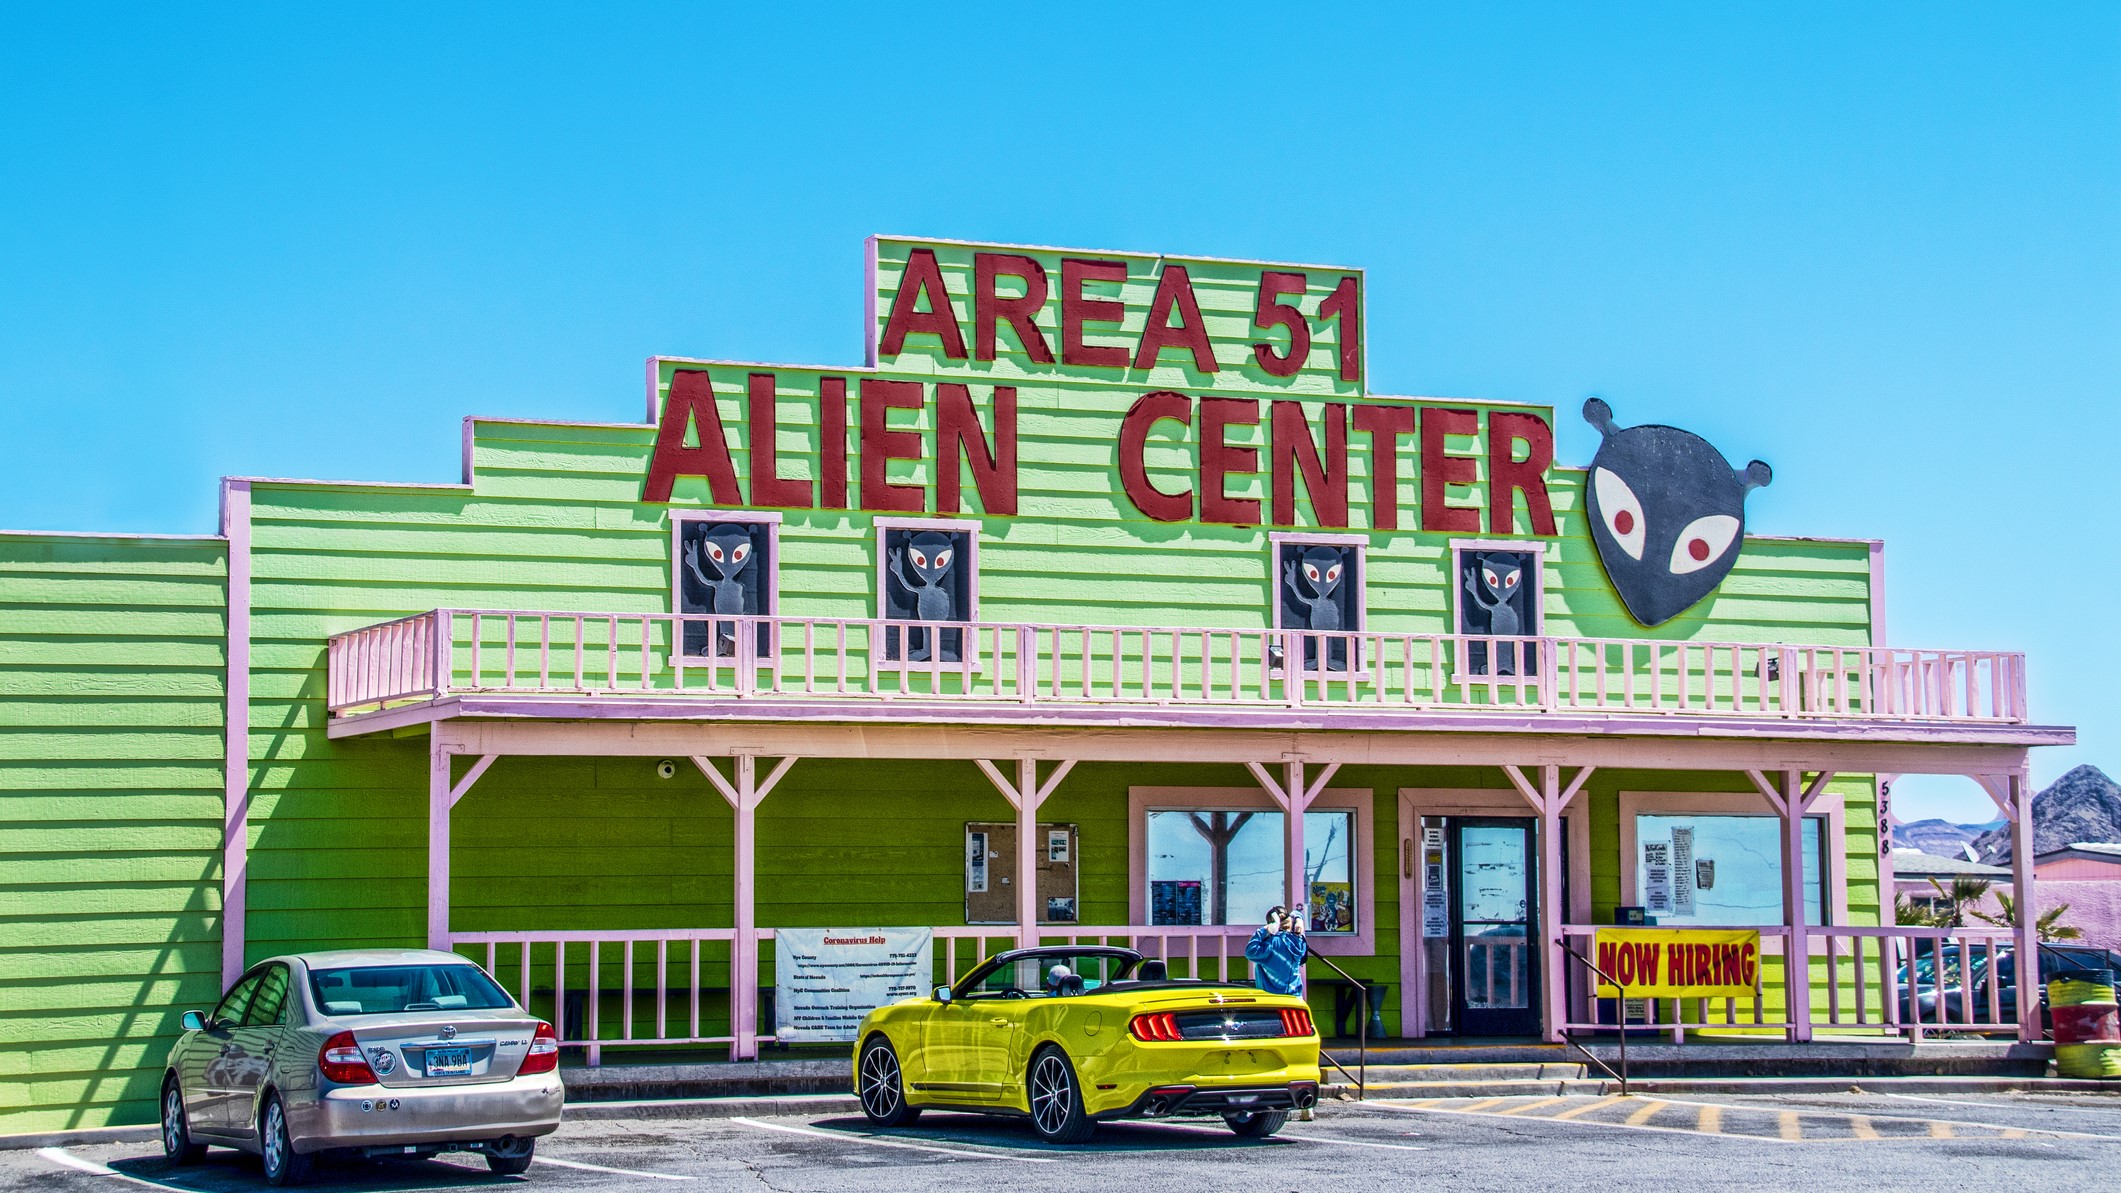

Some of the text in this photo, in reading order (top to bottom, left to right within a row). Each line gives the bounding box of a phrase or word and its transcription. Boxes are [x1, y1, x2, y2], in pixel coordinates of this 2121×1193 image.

[880, 249, 1360, 382] AREA 51
[642, 370, 1558, 536] ALIEN CENTER
[1879, 780, 1890, 856] 5388
[823, 936, 886, 945] Coronavirus Help
[1599, 941, 1755, 987] NOW HIRING
